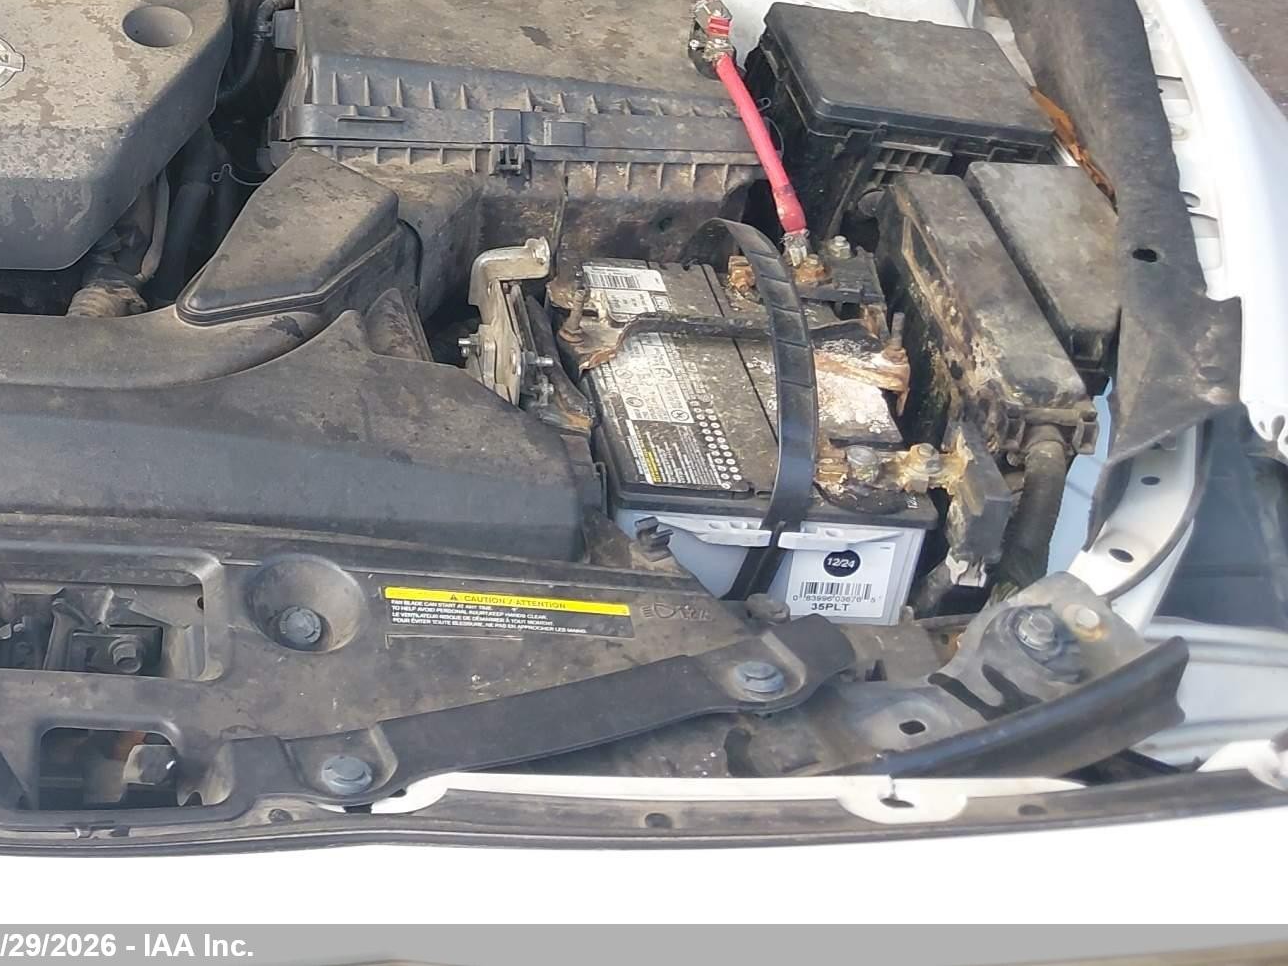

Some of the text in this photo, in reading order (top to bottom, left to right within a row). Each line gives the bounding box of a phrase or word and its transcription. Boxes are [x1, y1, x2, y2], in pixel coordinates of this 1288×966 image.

[827, 557, 855, 568] 12/24
[464, 595, 504, 604] CAUTION
[516, 599, 565, 609] ATTENTION
[811, 603, 850, 611] 35PLT
